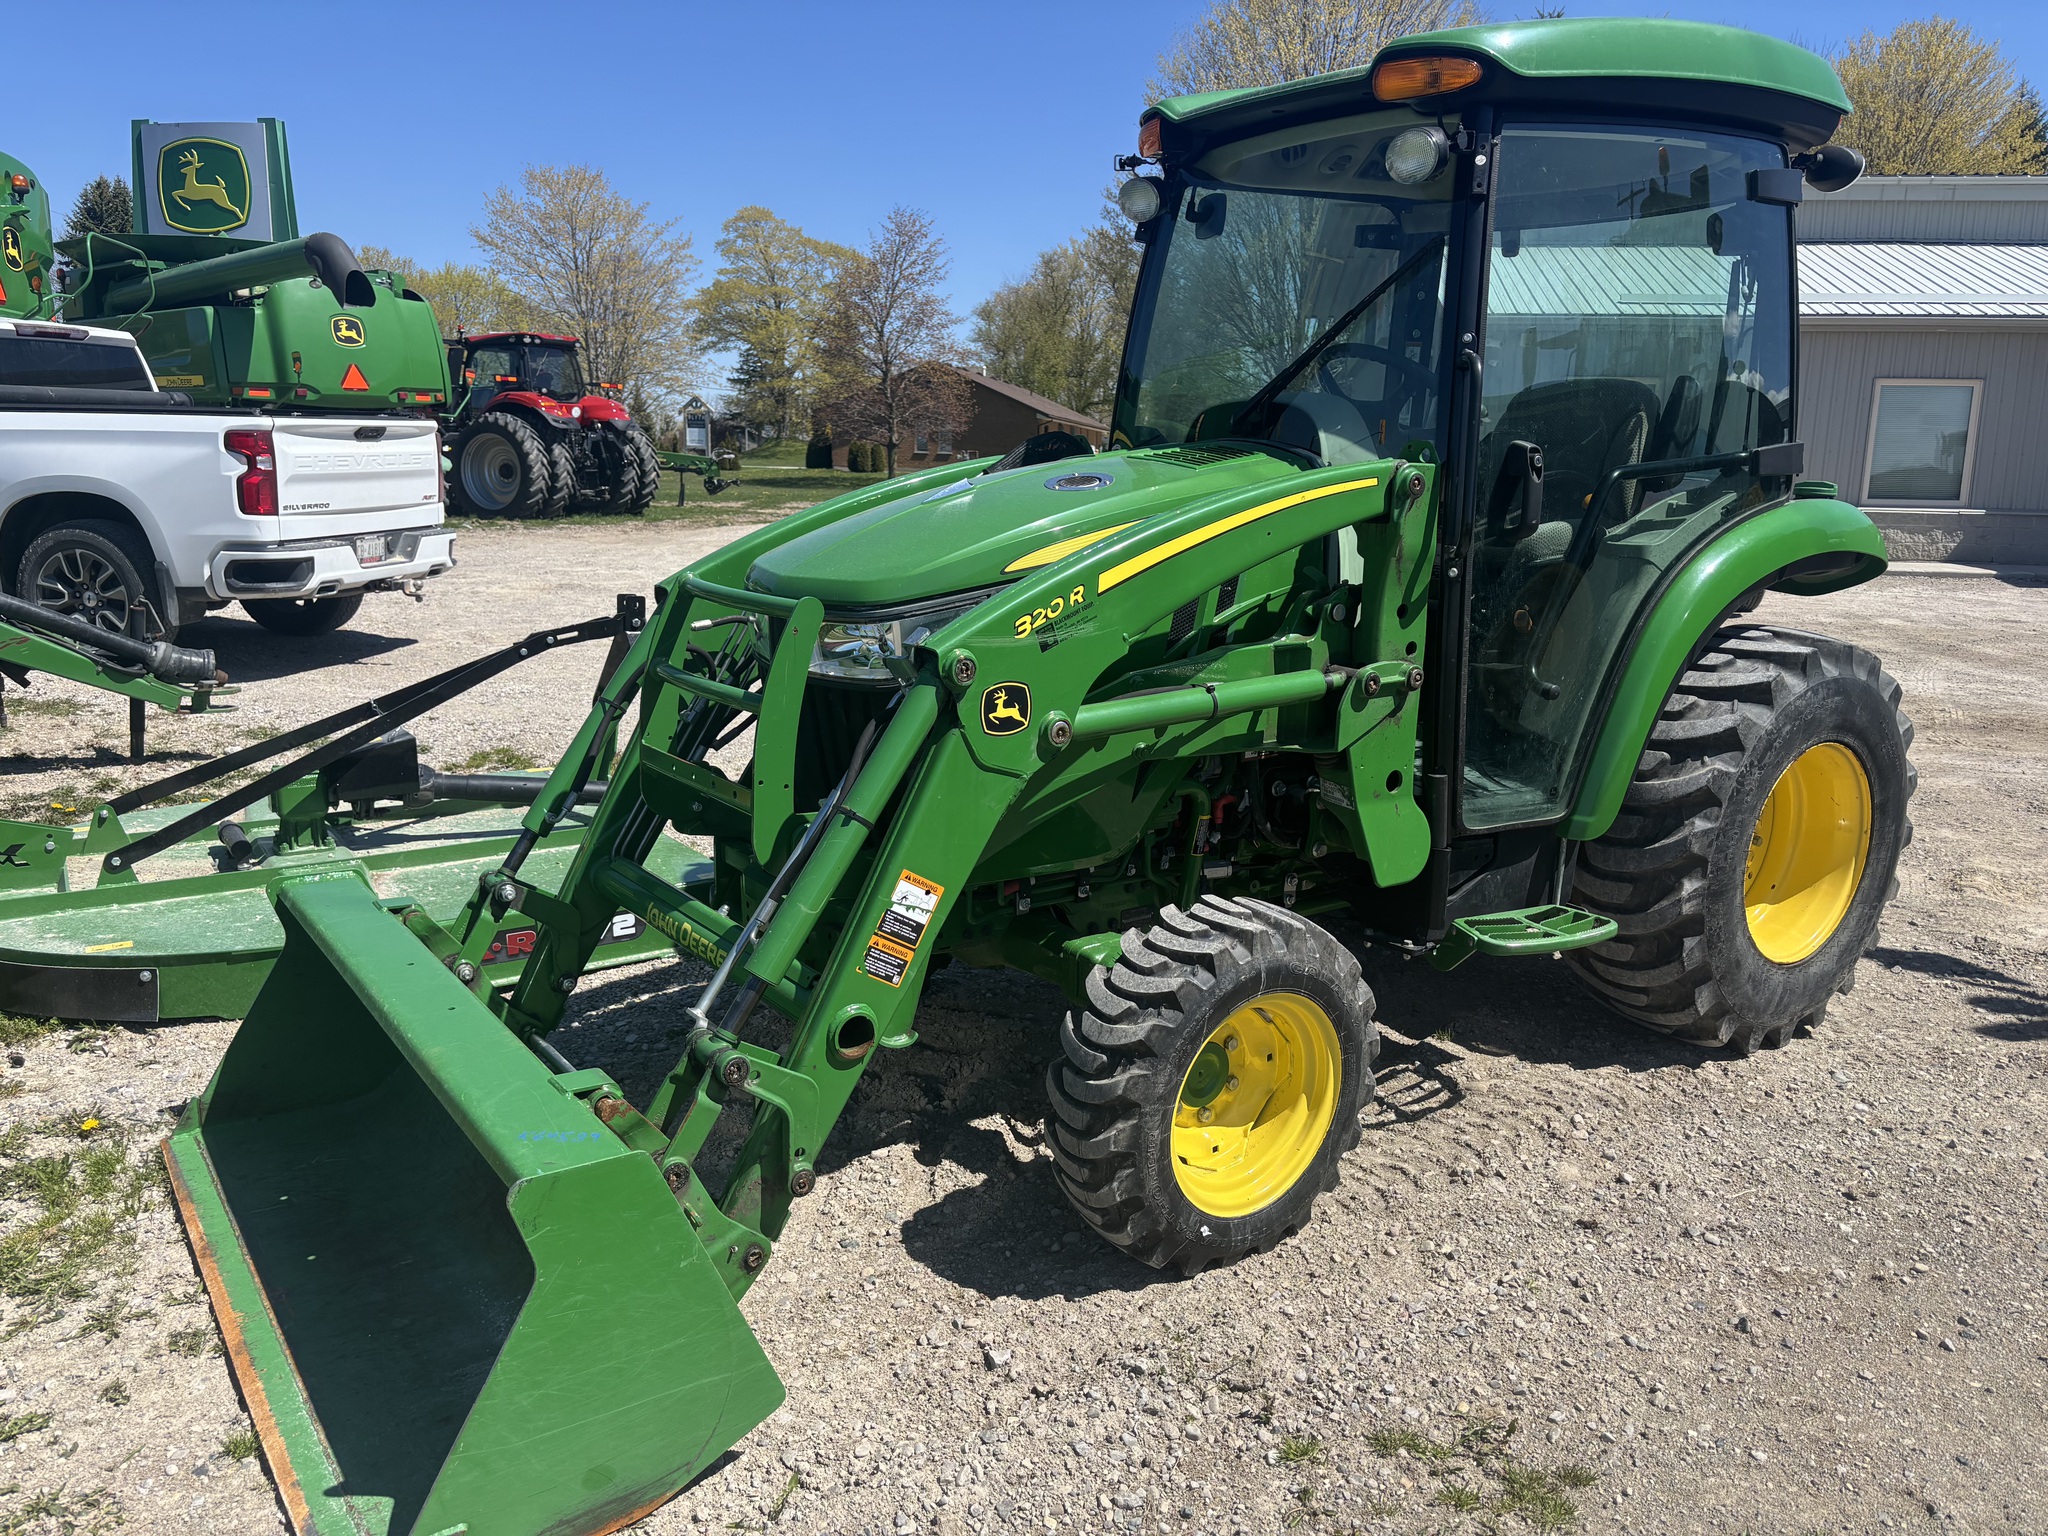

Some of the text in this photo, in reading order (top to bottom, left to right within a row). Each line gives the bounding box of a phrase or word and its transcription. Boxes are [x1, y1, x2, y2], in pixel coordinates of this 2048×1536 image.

[294, 453, 433, 471] CHEVROLET
[282, 503, 331, 511] SILVERADO
[1014, 595, 1065, 638] 320
[1069, 583, 1086, 607] R
[911, 875, 939, 893] WARNING
[646, 902, 730, 968] JOHN DEERE
[881, 942, 909, 959] WARNING
